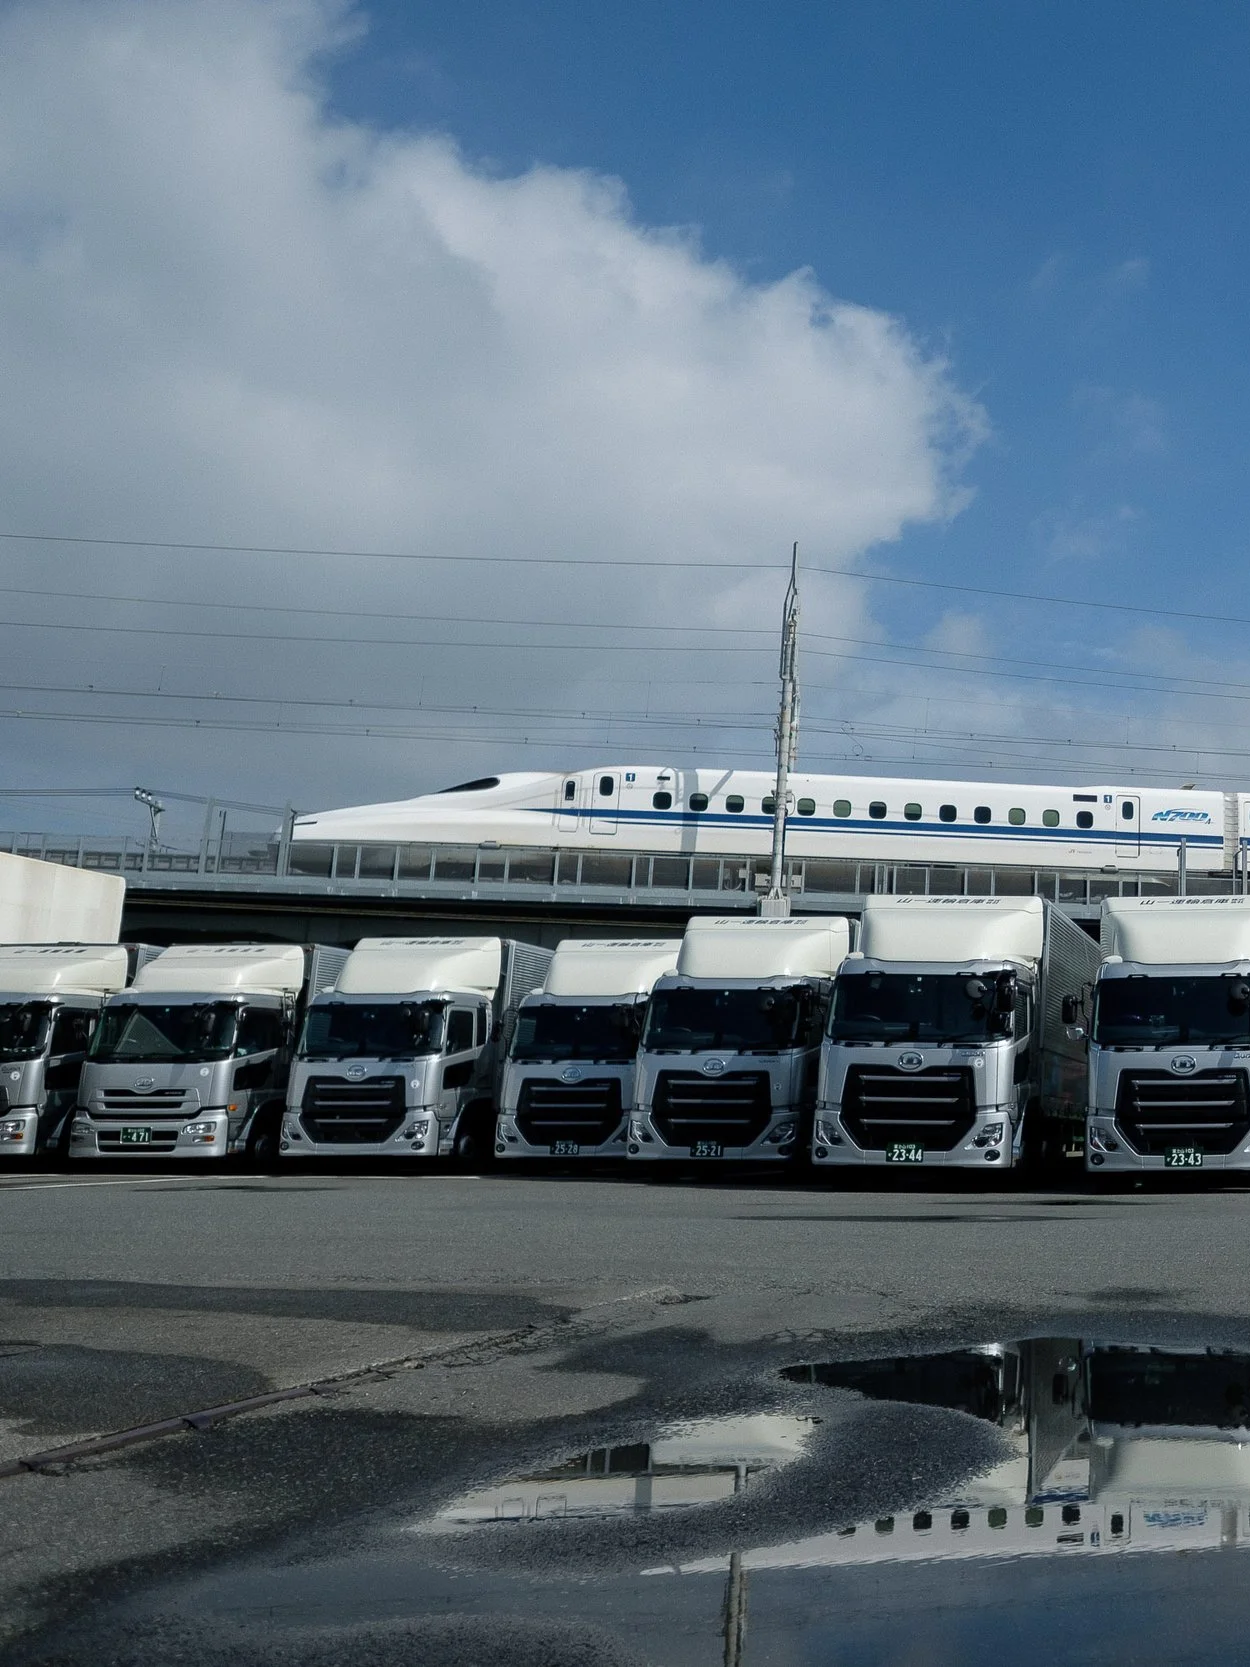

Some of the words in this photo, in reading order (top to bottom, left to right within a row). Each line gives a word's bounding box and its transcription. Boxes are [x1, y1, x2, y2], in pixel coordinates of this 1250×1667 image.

[695, 1145, 721, 1156] 25-21
[892, 1149, 922, 1161] 23-44
[1171, 1153, 1201, 1165] 23-43
